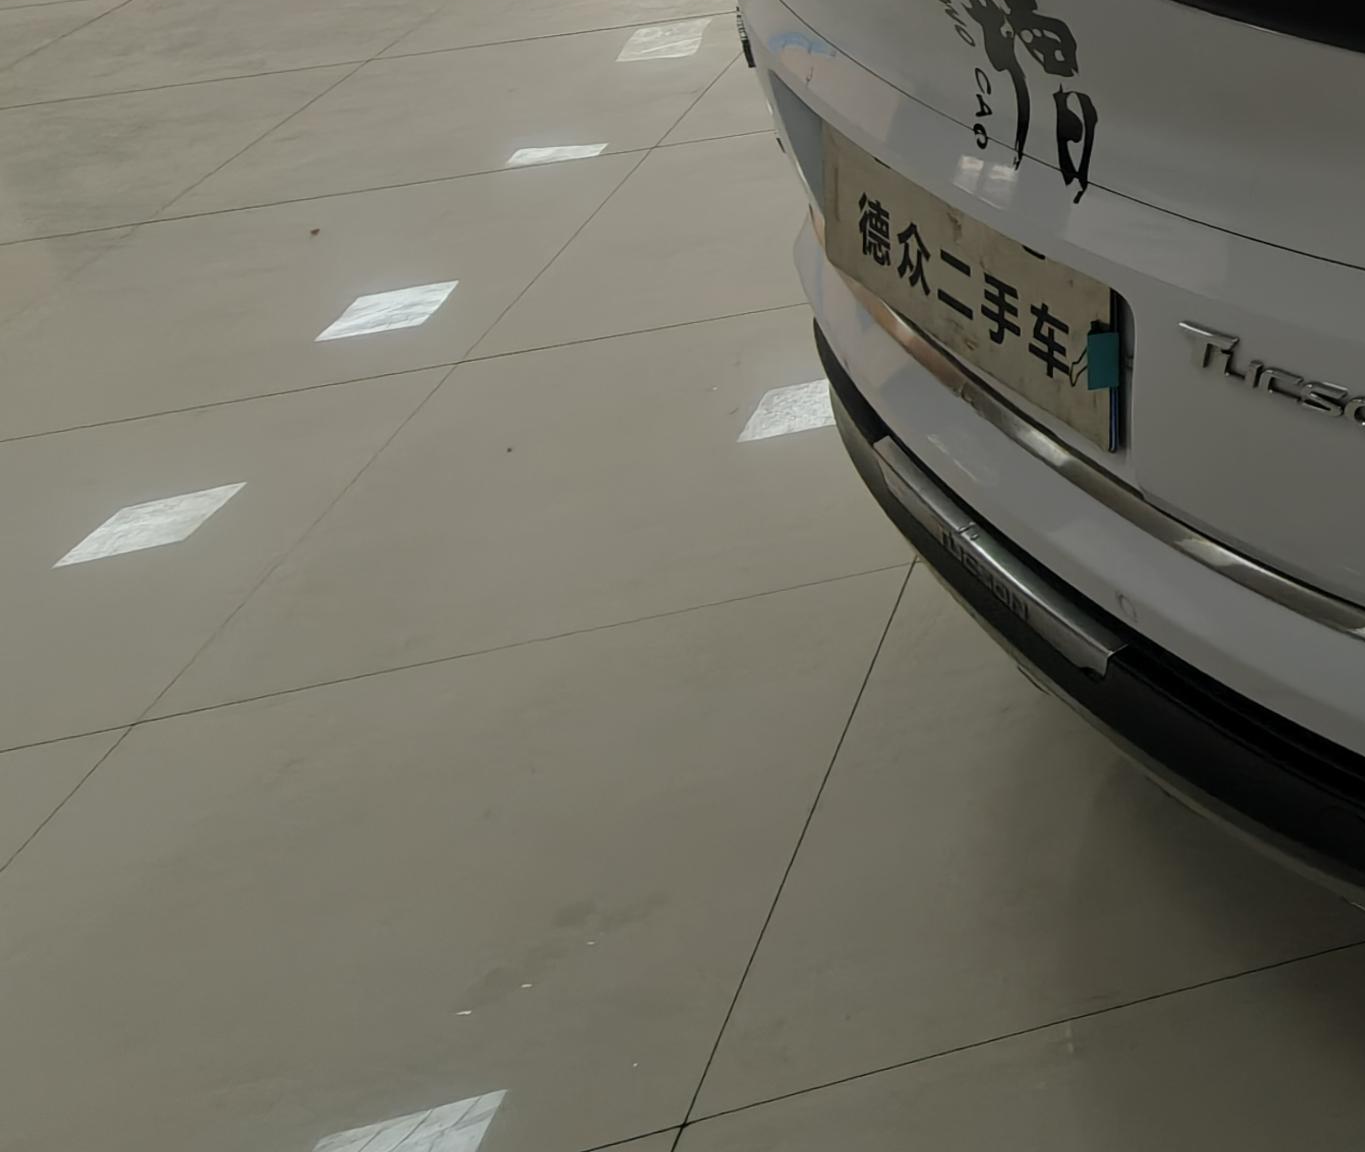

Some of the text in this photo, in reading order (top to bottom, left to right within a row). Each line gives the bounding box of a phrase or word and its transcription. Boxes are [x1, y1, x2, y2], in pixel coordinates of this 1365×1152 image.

[858, 192, 1070, 379] 德众二手车
